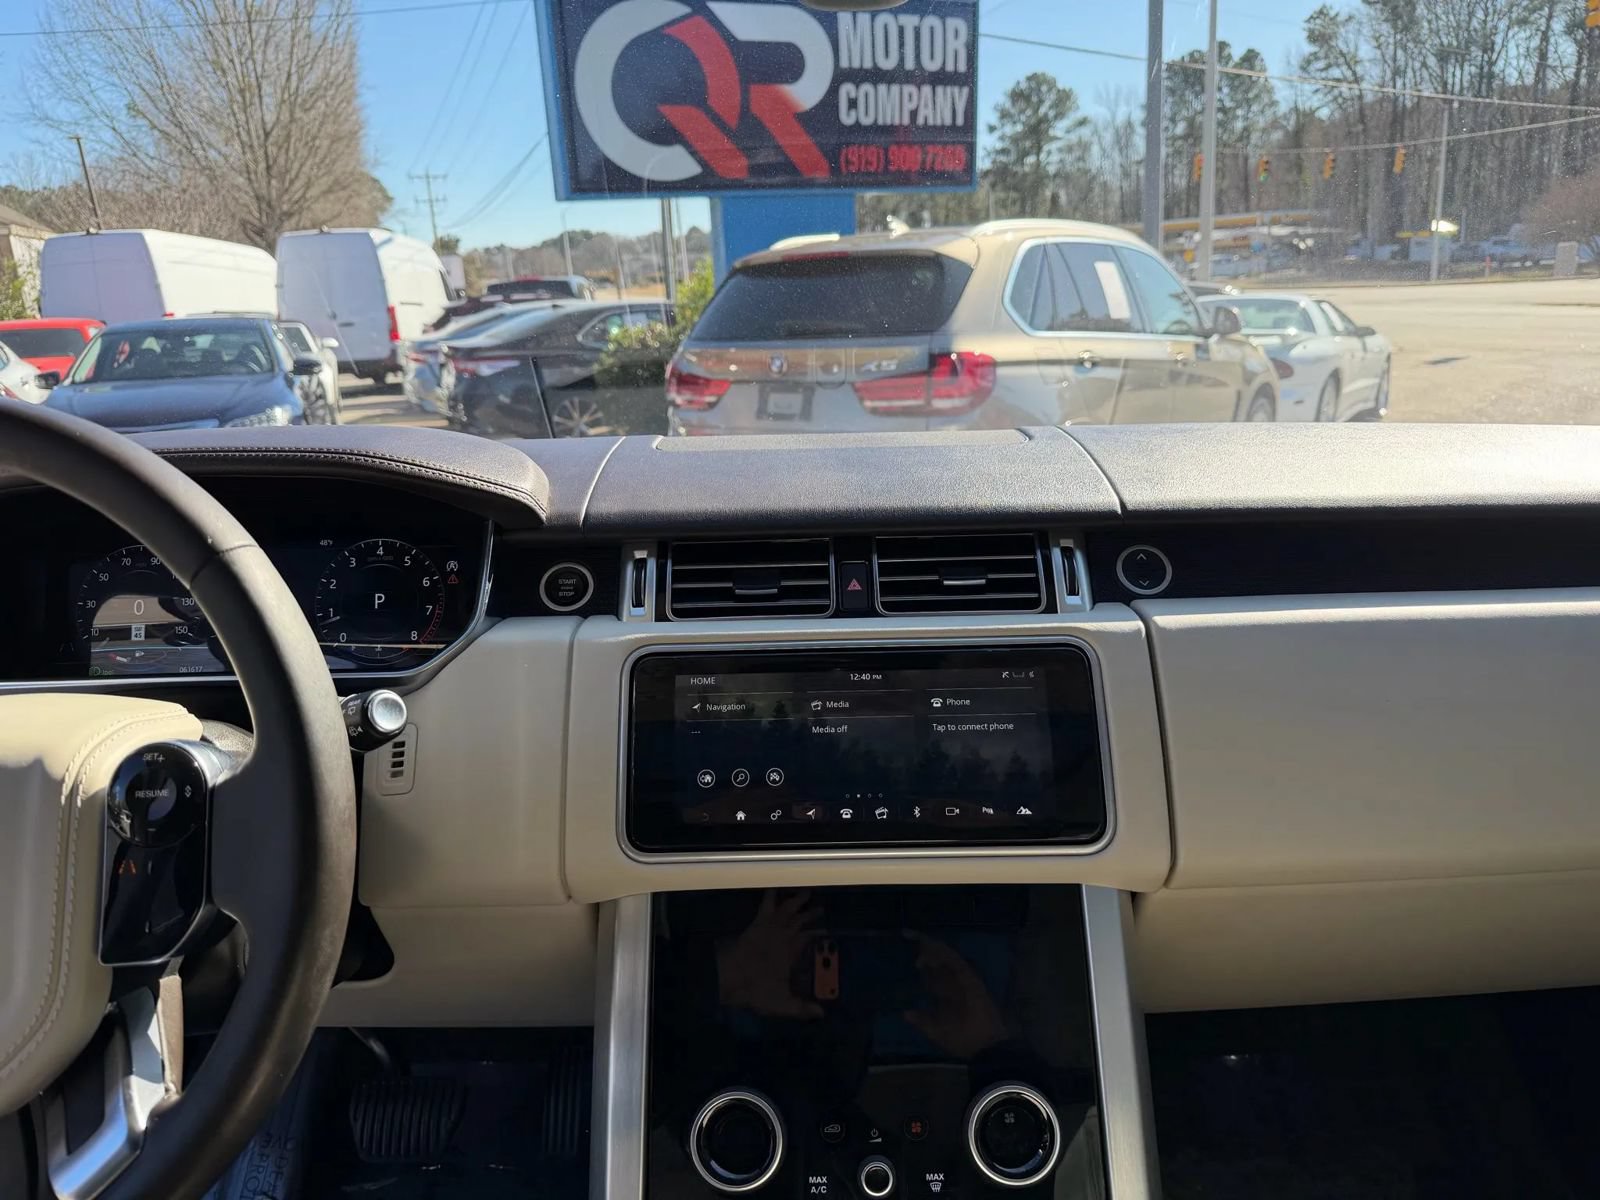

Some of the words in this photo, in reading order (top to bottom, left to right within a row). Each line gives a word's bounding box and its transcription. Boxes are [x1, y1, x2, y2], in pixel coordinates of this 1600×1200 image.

[837, 11, 968, 71] MOTOR
[838, 82, 969, 126] COMPANY
[839, 145, 885, 175] (919)
[376, 546, 384, 556] 4
[121, 557, 132, 567] 70
[150, 557, 161, 566] 90
[349, 557, 357, 568] 3
[403, 556, 411, 566] 5
[99, 572, 109, 582] 50
[422, 576, 430, 587] 6
[329, 579, 337, 589] 2
[85, 600, 97, 609] 30
[181, 597, 195, 606] 130
[374, 593, 385, 609] P
[134, 599, 144, 615] 0
[425, 605, 433, 616] 7
[328, 607, 334, 618] 1
[90, 628, 99, 637] 10
[175, 625, 189, 635] 150
[339, 632, 347, 643] 0
[410, 630, 418, 641] 8
[690, 676, 716, 685] HOME
[850, 673, 871, 681] 12:40
[826, 700, 849, 709] Media
[946, 697, 971, 706] Phone
[706, 702, 746, 713] Navigation
[811, 725, 836, 734] Media
[837, 724, 848, 733] off
[932, 723, 946, 733] Tap
[948, 723, 956, 731] to
[957, 722, 988, 731] connect
[990, 722, 1014, 732] phone
[135, 788, 169, 799] RESUME
[808, 1176, 828, 1184] MAX
[926, 1173, 945, 1181] MAX
[810, 1186, 827, 1194] A/C
